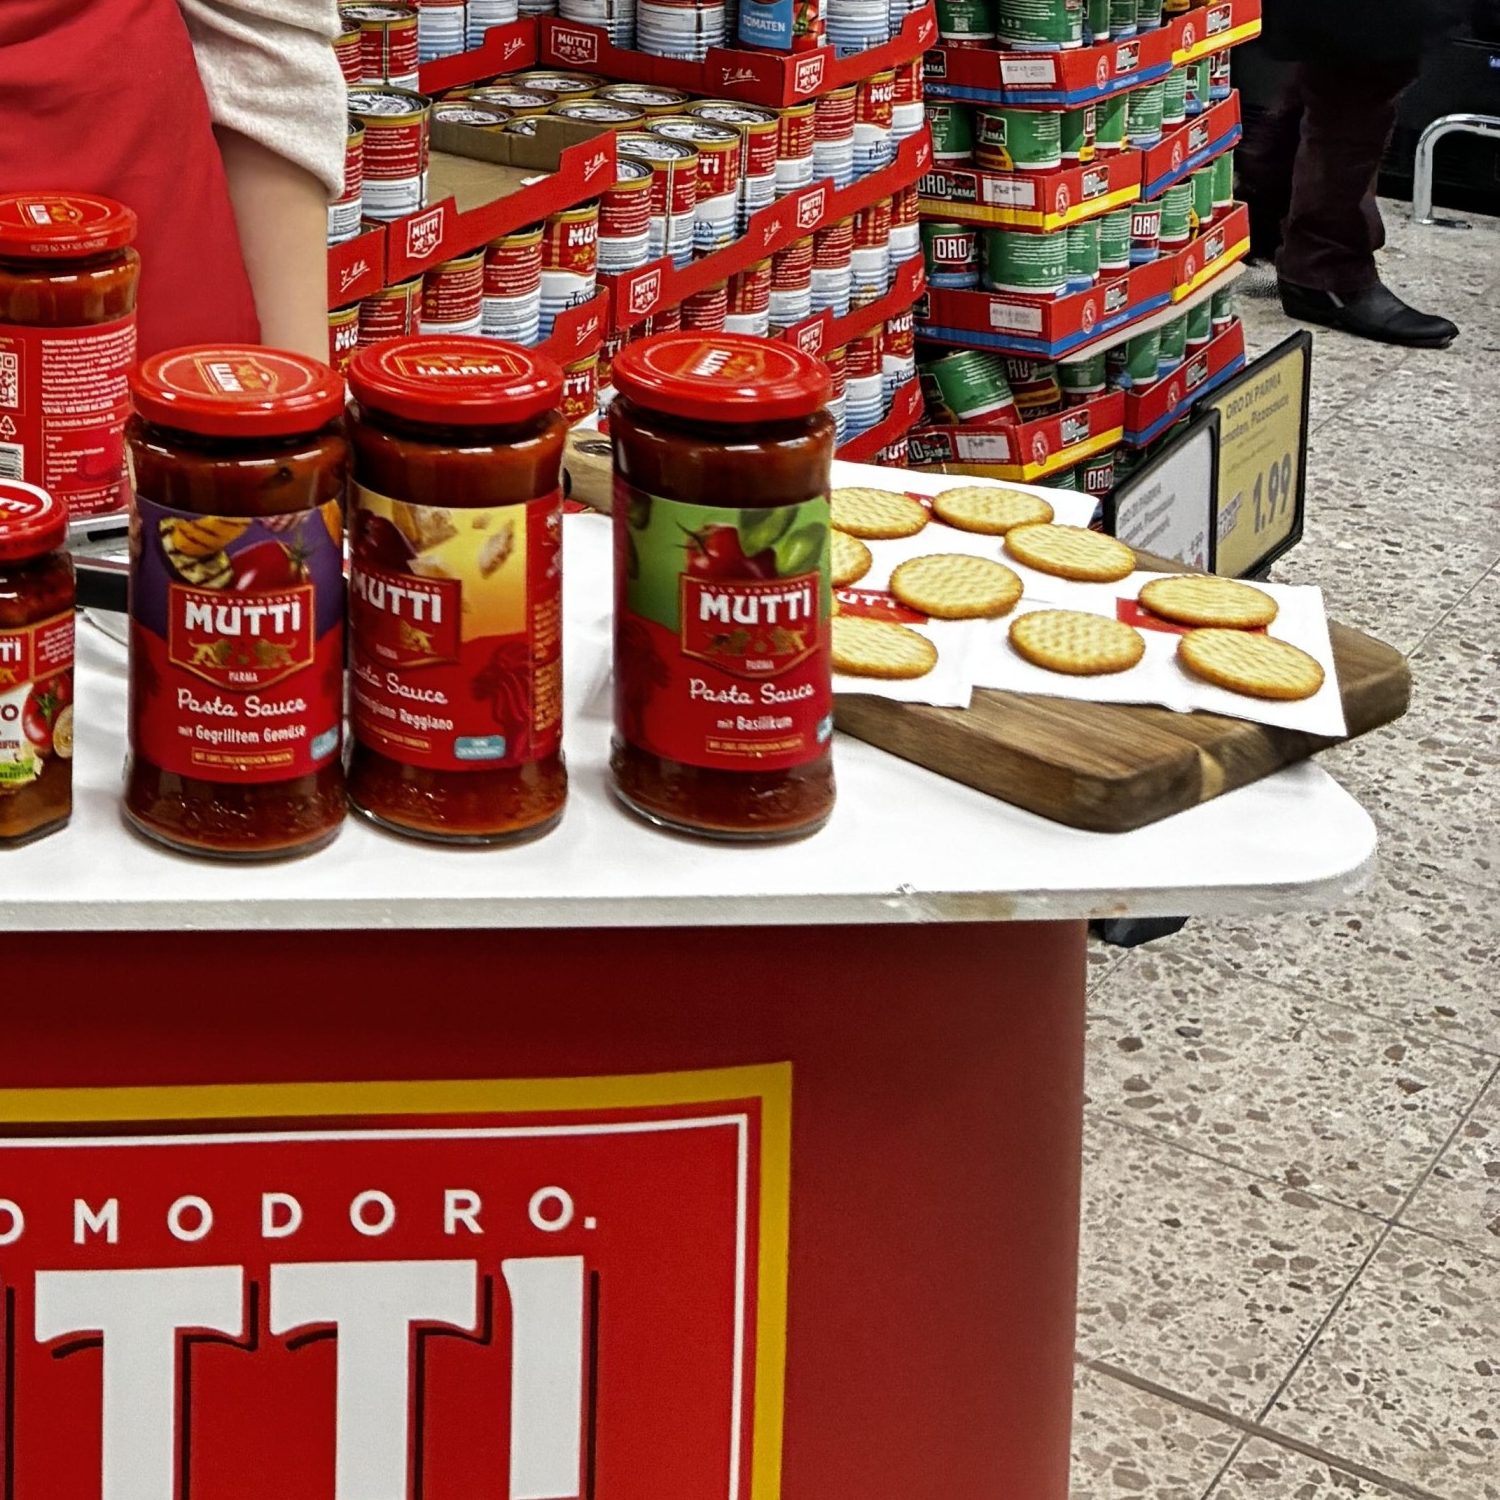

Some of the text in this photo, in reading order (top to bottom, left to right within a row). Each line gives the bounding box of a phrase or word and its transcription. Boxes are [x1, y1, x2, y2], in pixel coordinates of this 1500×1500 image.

[742, 13, 786, 32] TOMATEN
[557, 32, 592, 48] MUTTI
[936, 239, 967, 258] ORO
[1253, 452, 1292, 533] 1.99
[699, 589, 810, 625] MUTTI
[185, 601, 300, 636] MUTTI
[229, 671, 258, 682] PARMA
[386, 672, 448, 705] Sauce
[689, 678, 815, 705] Pasta Sauce
[177, 687, 307, 717] Pasta Sauce
[400, 709, 453, 731] Reggiano
[736, 716, 792, 731] Basilikum
[196, 725, 259, 745] Gegrilltem
[264, 724, 306, 742] Gemüse
